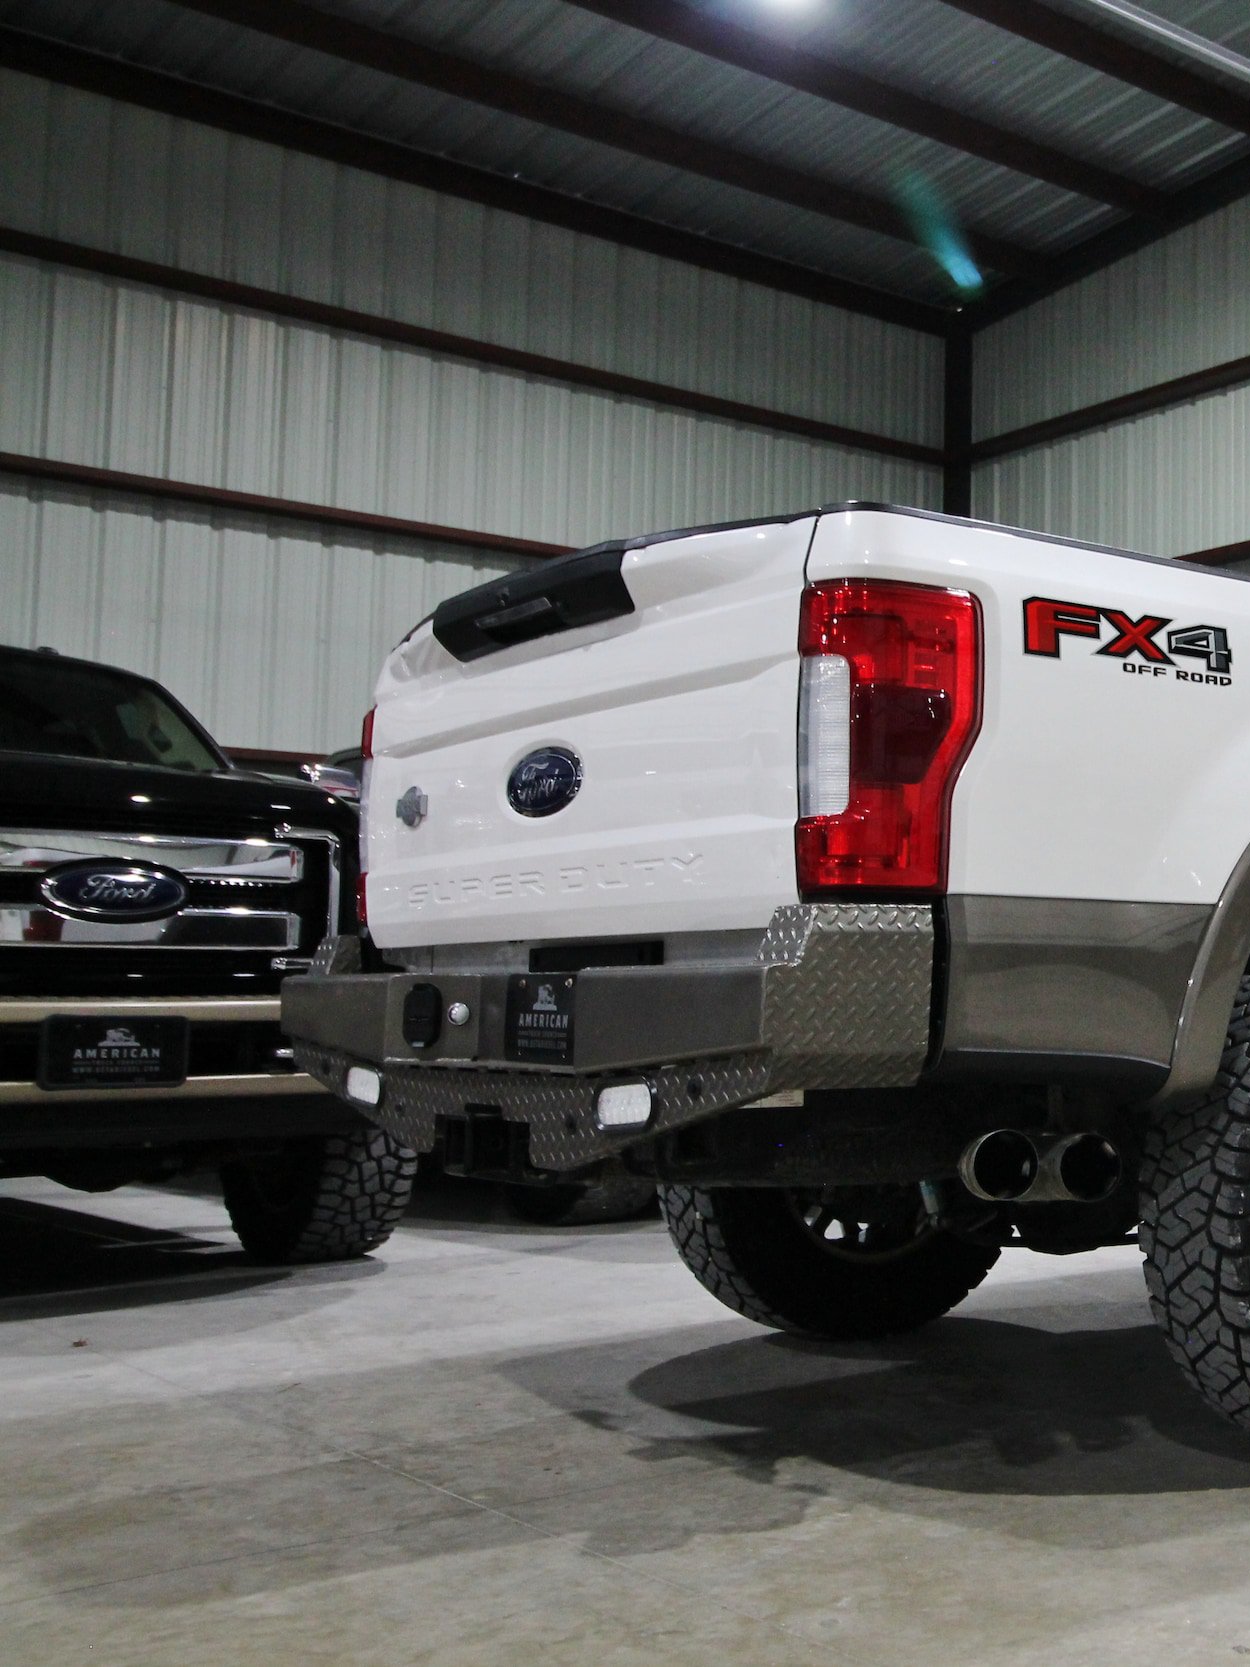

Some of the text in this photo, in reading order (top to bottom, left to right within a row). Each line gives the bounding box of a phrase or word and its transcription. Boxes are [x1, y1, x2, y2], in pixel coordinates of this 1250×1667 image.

[1022, 596, 1232, 674] FX4
[1122, 662, 1232, 686] OFF ROAD
[518, 761, 559, 805] Ford
[79, 873, 156, 900] Ford
[408, 854, 704, 904] SUPER DUTY
[518, 1013, 568, 1029] AMERICAN
[73, 1048, 160, 1059] AMERICAN
